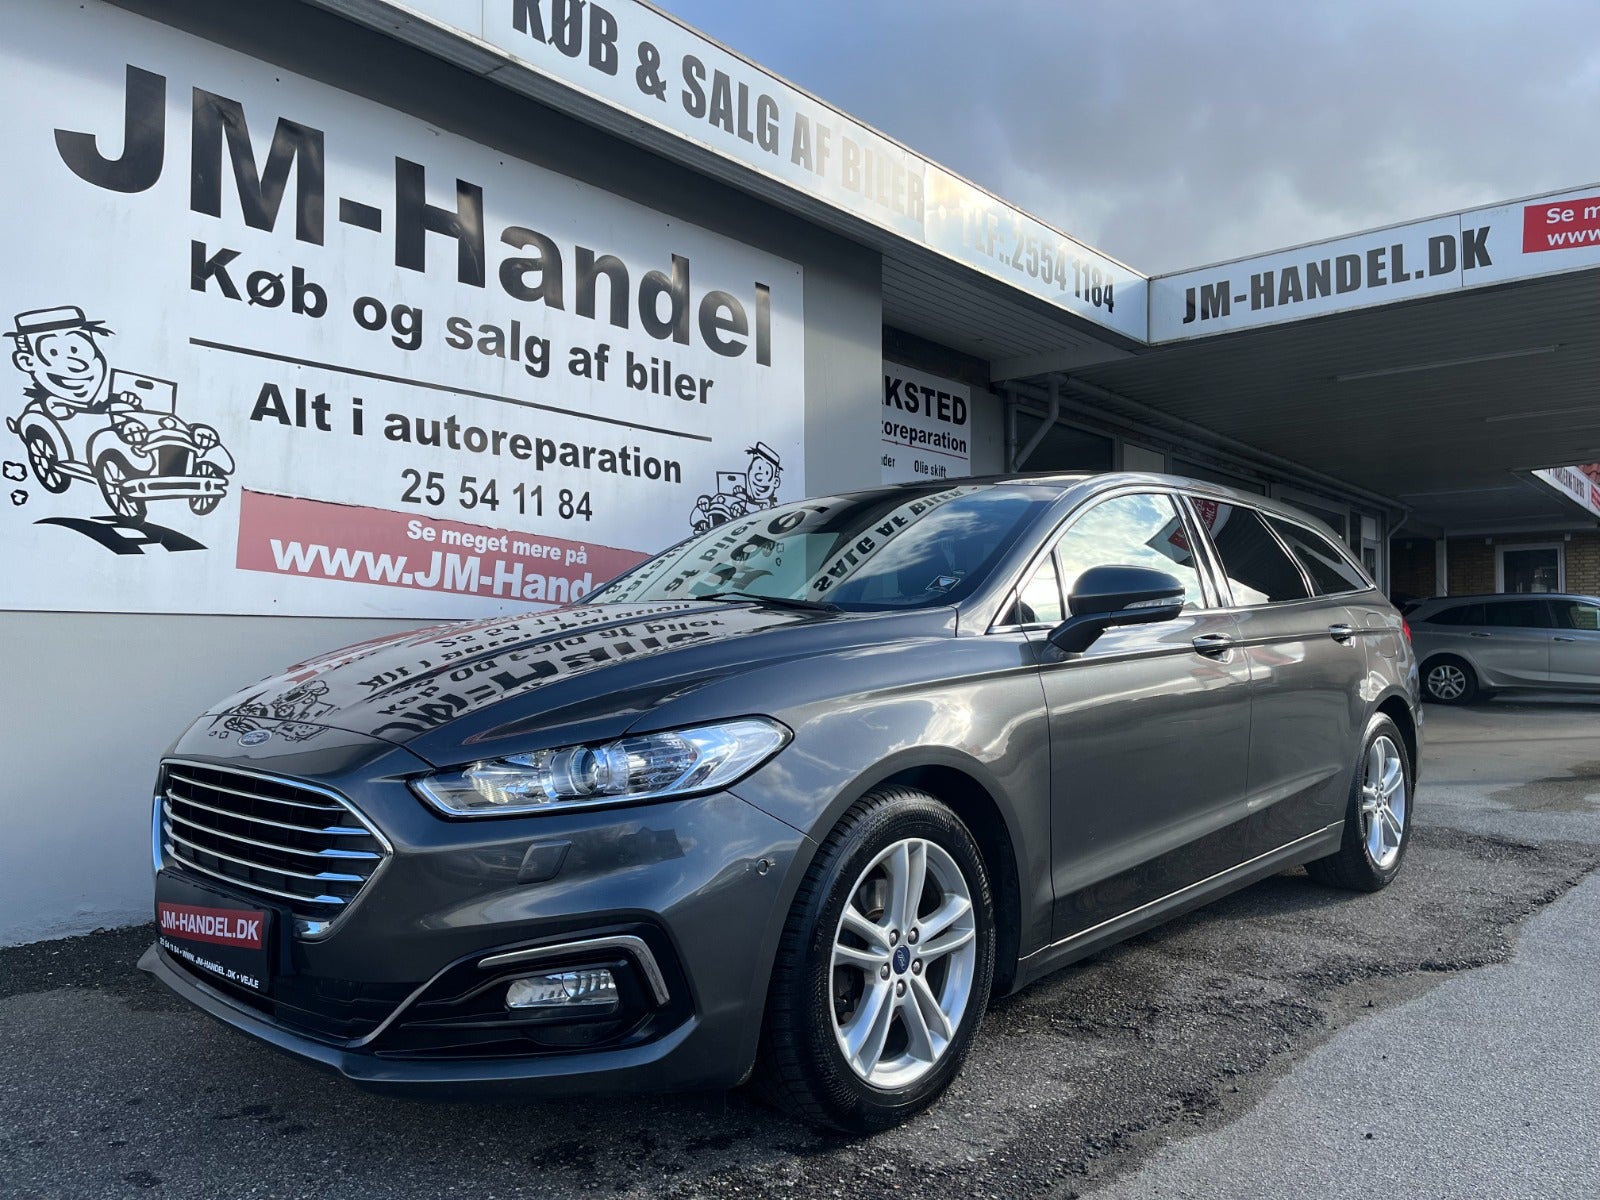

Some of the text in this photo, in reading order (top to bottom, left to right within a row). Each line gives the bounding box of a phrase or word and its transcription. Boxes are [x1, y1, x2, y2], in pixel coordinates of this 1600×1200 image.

[513, 0, 618, 76] KØB
[636, 42, 667, 102] &
[681, 54, 780, 156] SALG
[790, 112, 831, 177] AF
[842, 136, 925, 224] BILER
[1072, 258, 1115, 313] 1184
[54, 64, 773, 367] JM-Handel
[1546, 208, 1574, 224] Se
[1183, 226, 1493, 325] JM-HANDEL.DK
[190, 240, 714, 405] Køb og salg af biler
[882, 375, 967, 426] KSTED
[250, 383, 682, 484] Alt i autoreparation
[882, 421, 967, 453] oreparation
[882, 454, 947, 478] der Olie skift
[400, 468, 592, 521] 25 54 11 84
[407, 520, 587, 566] Se meget mere på
[270, 539, 605, 603] www.JM-Hand
[161, 910, 259, 941] JM-HANDEL.DK
[240, 974, 259, 989] VEJLE
